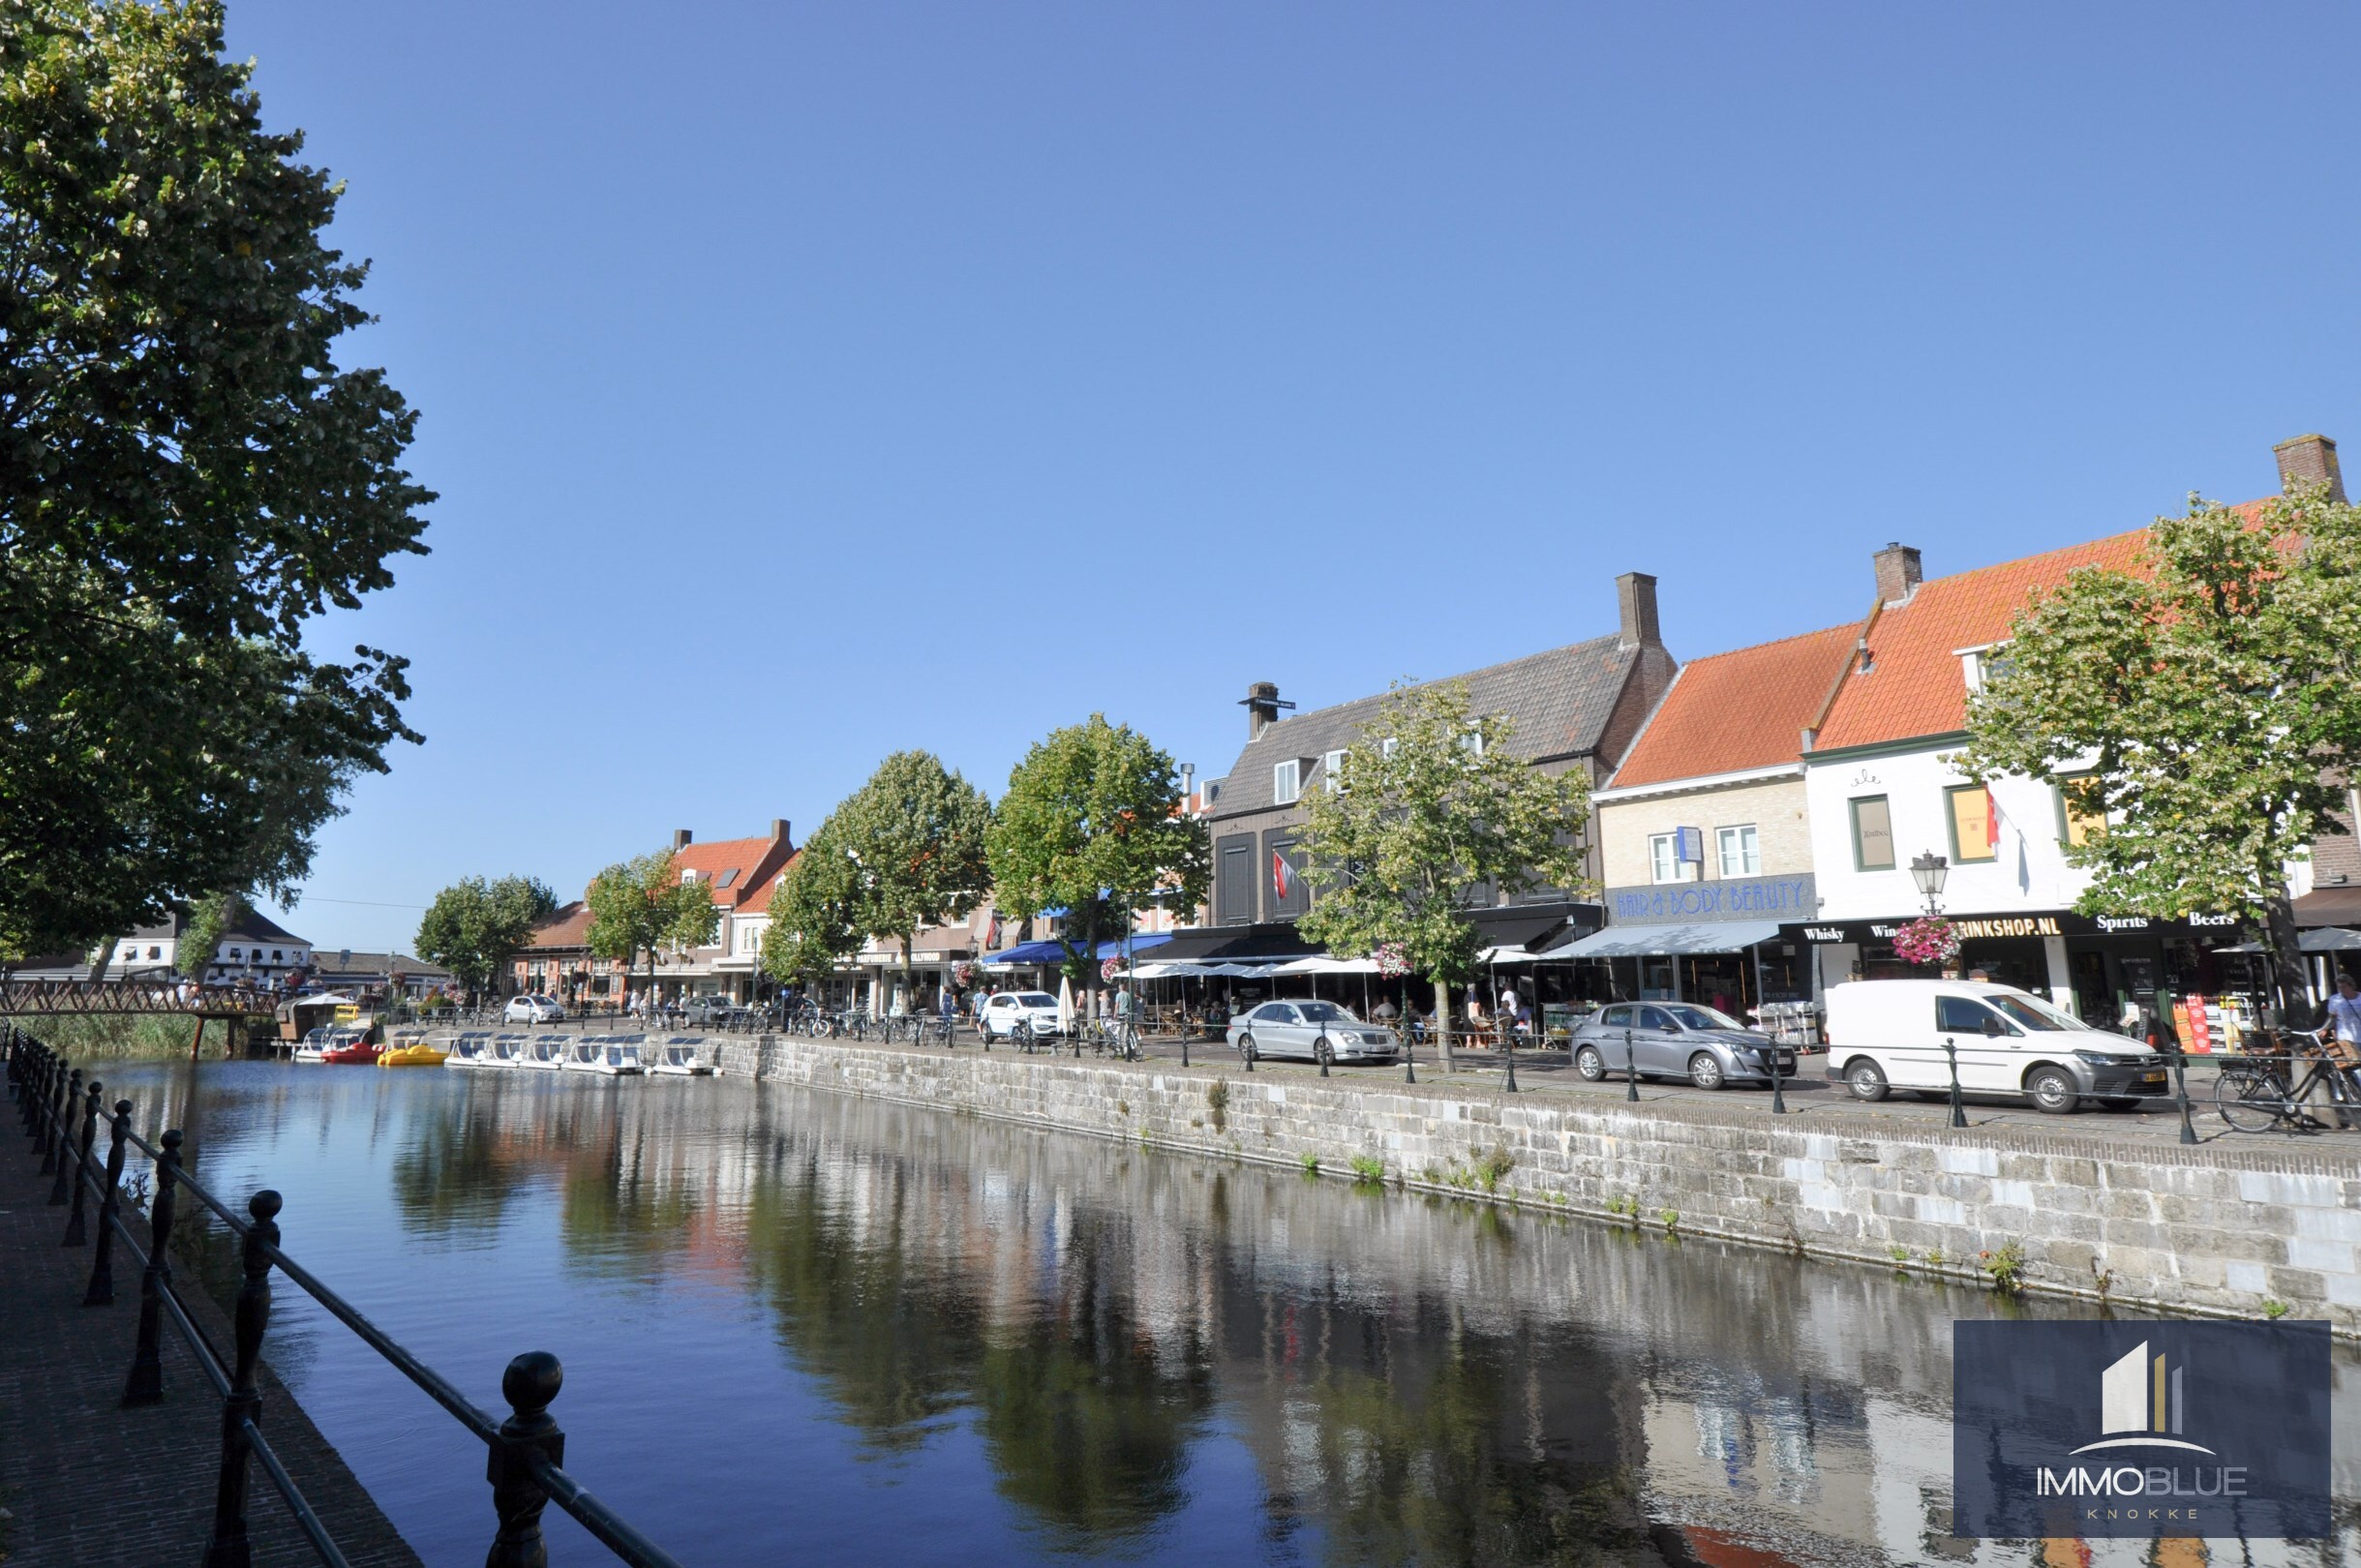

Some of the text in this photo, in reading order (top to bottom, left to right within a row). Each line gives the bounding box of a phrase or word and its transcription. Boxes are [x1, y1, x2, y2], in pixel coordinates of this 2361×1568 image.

[1617, 890, 1649, 918] HAIR
[1670, 887, 1723, 915] BODY
[1729, 881, 1803, 912] BEAUTY
[2096, 914, 2149, 932] Spirits
[2189, 911, 2235, 926] Beers
[1803, 926, 1845, 943] Whisky
[1870, 924, 1899, 938] Win
[1956, 917, 2061, 938] RINKSHOP.NL
[910, 951, 941, 962] OLLYWOOD
